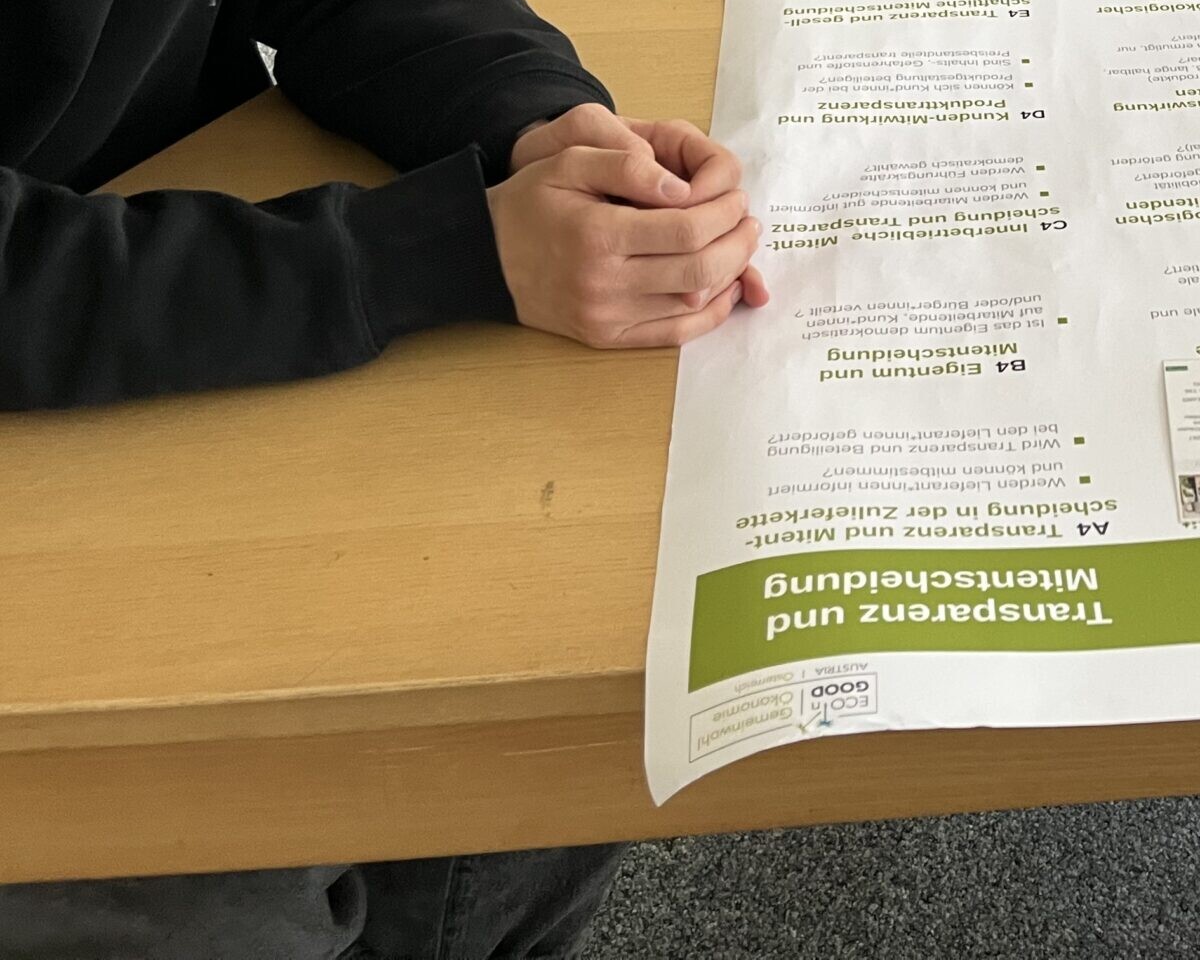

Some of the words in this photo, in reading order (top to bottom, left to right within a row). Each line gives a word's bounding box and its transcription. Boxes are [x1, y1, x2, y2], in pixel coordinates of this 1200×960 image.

[784, 2, 930, 16] Mitentscheidung
[937, 0, 1031, 8] schaftliche
[785, 15, 844, 27] gesell-
[850, 15, 883, 24] und
[890, 10, 998, 20] Transparenz
[1008, 10, 1030, 18] E4
[818, 100, 1006, 111] Produkttransparenz
[778, 116, 814, 125] und
[822, 112, 1009, 126] Kunden-Mitwirkung
[1020, 110, 1046, 120] D4
[909, 215, 947, 227] und
[955, 207, 1061, 222] scheidung
[772, 217, 902, 233] Transparenz
[852, 223, 1028, 242] Innerbetriebliche
[1040, 220, 1068, 231] C4
[766, 236, 838, 252] Mitent-
[828, 343, 1018, 363] Mitentscheidung
[872, 361, 982, 378] Eigentum
[995, 359, 1026, 374] B4
[820, 369, 864, 383] und
[906, 507, 948, 521] der
[956, 507, 978, 517] in
[988, 500, 1118, 519] scheidung
[736, 507, 898, 529] Zulieferkette
[846, 527, 894, 541] und
[904, 523, 1063, 538] Transparenz
[1077, 521, 1110, 537] A4
[745, 528, 835, 549] Mitent-
[764, 568, 1098, 599] Mitentscheidung
[859, 598, 1113, 626] Transparenz
[767, 606, 845, 641] und
[815, 663, 869, 676] AUSTRIA
[811, 681, 870, 698] GOOD
[712, 690, 793, 723] Ökonomie
[698, 707, 792, 750] Gemeinwohl
